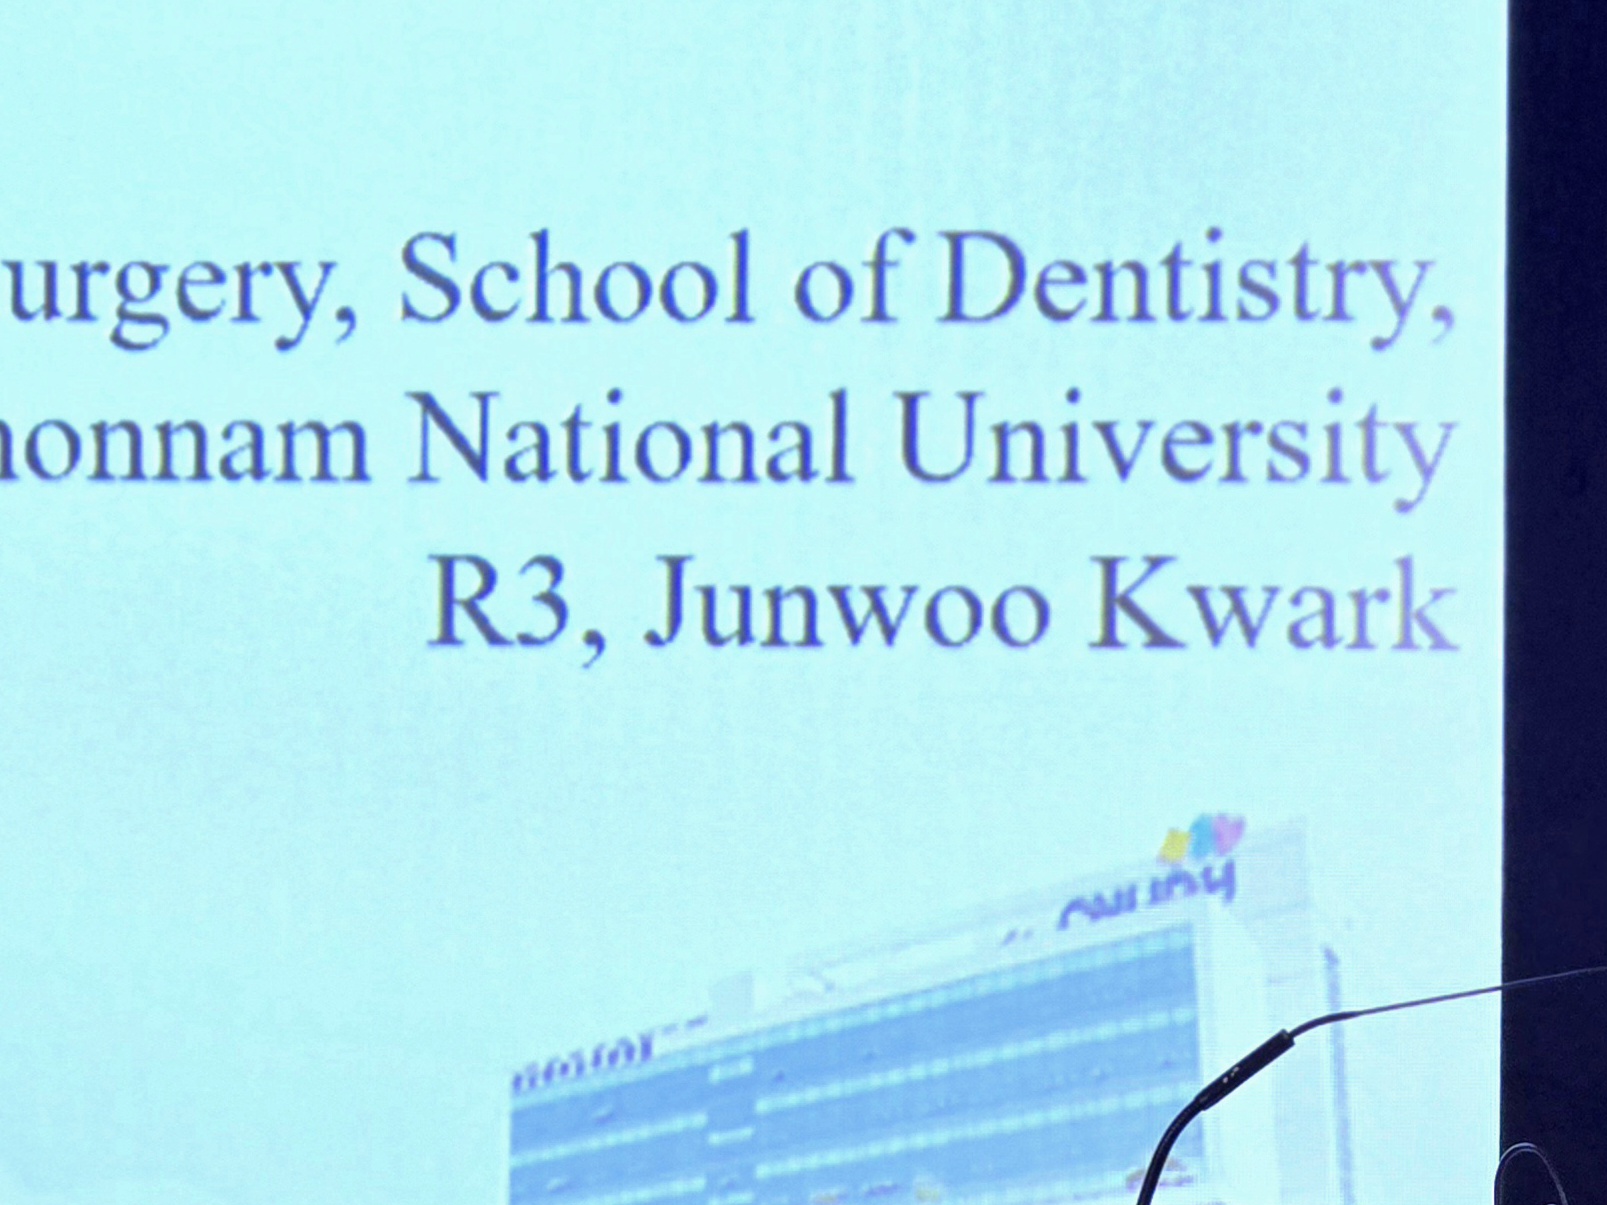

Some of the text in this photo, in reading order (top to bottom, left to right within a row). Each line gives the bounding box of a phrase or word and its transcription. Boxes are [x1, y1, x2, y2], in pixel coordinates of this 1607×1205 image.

[402, 227, 757, 325] School
[794, 226, 917, 325] of
[936, 226, 1456, 353] Dentistry,
[404, 387, 856, 486] National
[892, 387, 1458, 515] University
[426, 553, 1460, 670] R3, Junwoo Kwark
